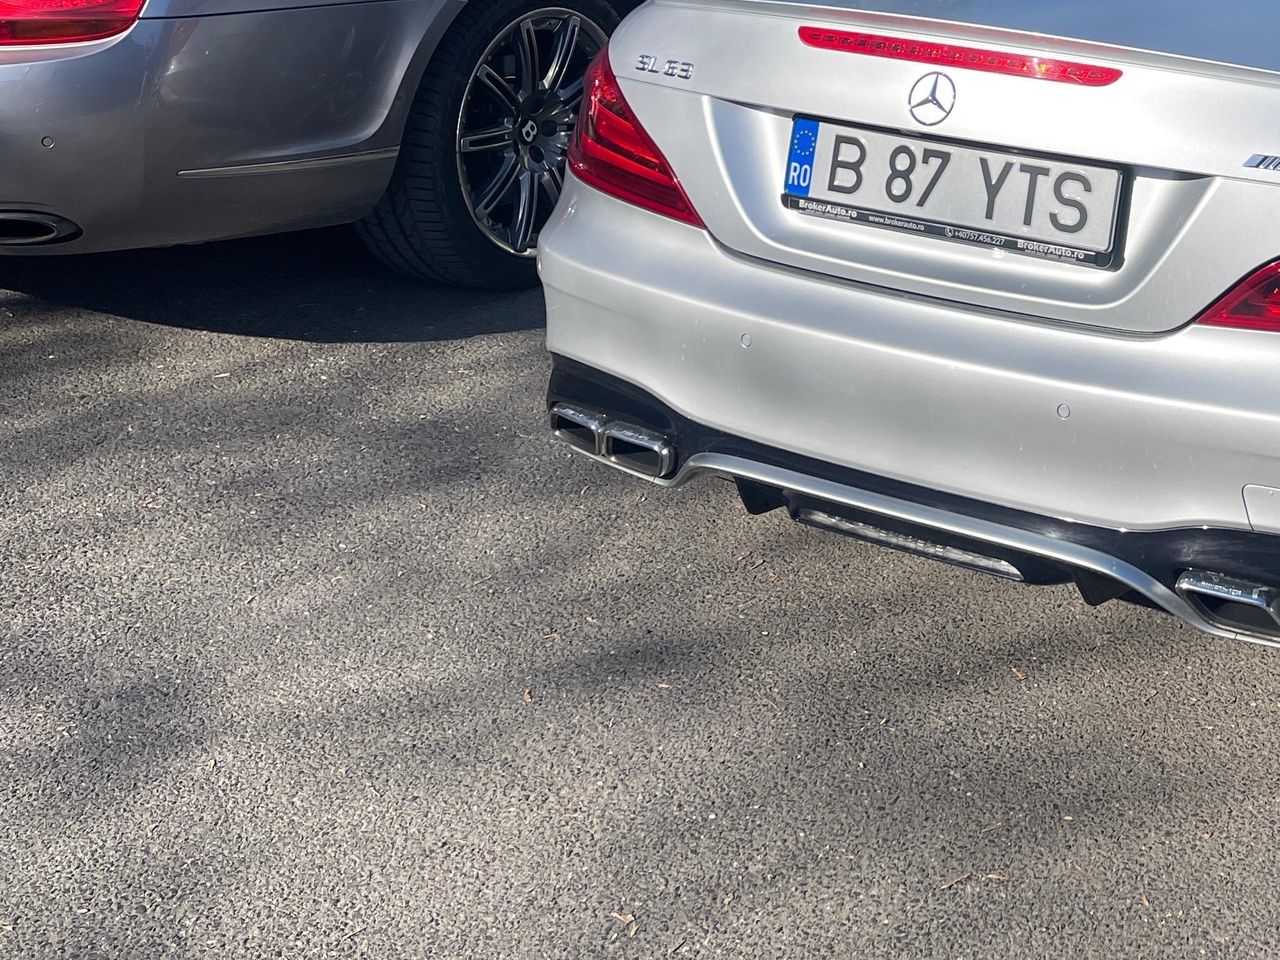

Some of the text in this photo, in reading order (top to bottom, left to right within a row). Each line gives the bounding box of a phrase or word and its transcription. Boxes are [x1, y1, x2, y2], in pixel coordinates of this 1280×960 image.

[635, 54, 695, 80] SL 63
[788, 162, 811, 187] RO
[827, 134, 1092, 234] B 87 YTS
[798, 199, 858, 218] BrokerAuto.ro
[868, 215, 925, 231] www.brokerauto.ro
[1017, 239, 1085, 260] BrokerAuto.ro
